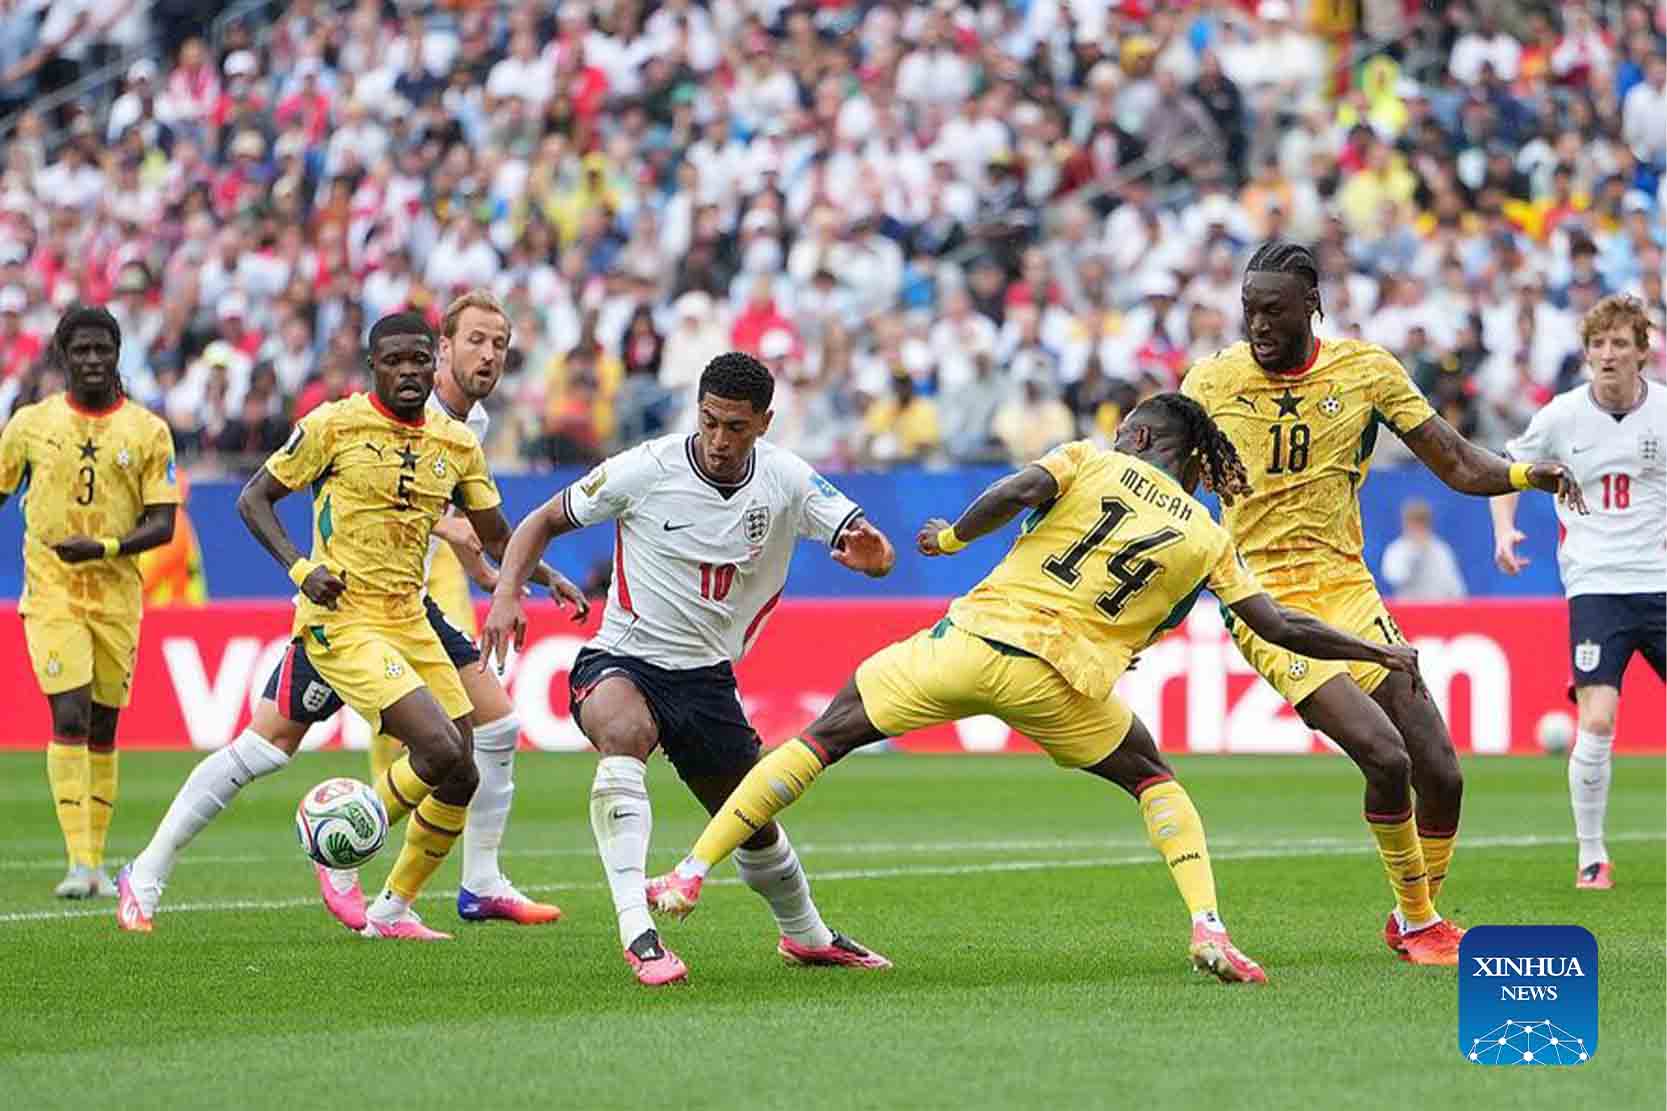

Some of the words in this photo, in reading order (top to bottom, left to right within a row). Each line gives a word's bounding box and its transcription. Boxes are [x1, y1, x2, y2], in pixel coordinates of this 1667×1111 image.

[1266, 423, 1312, 475] 18
[76, 466, 96, 506] 3
[397, 475, 417, 512] 5
[1119, 467, 1194, 522] MENSAH
[1600, 472, 1631, 510] 18
[1041, 495, 1186, 624] 14
[698, 562, 738, 602] 10
